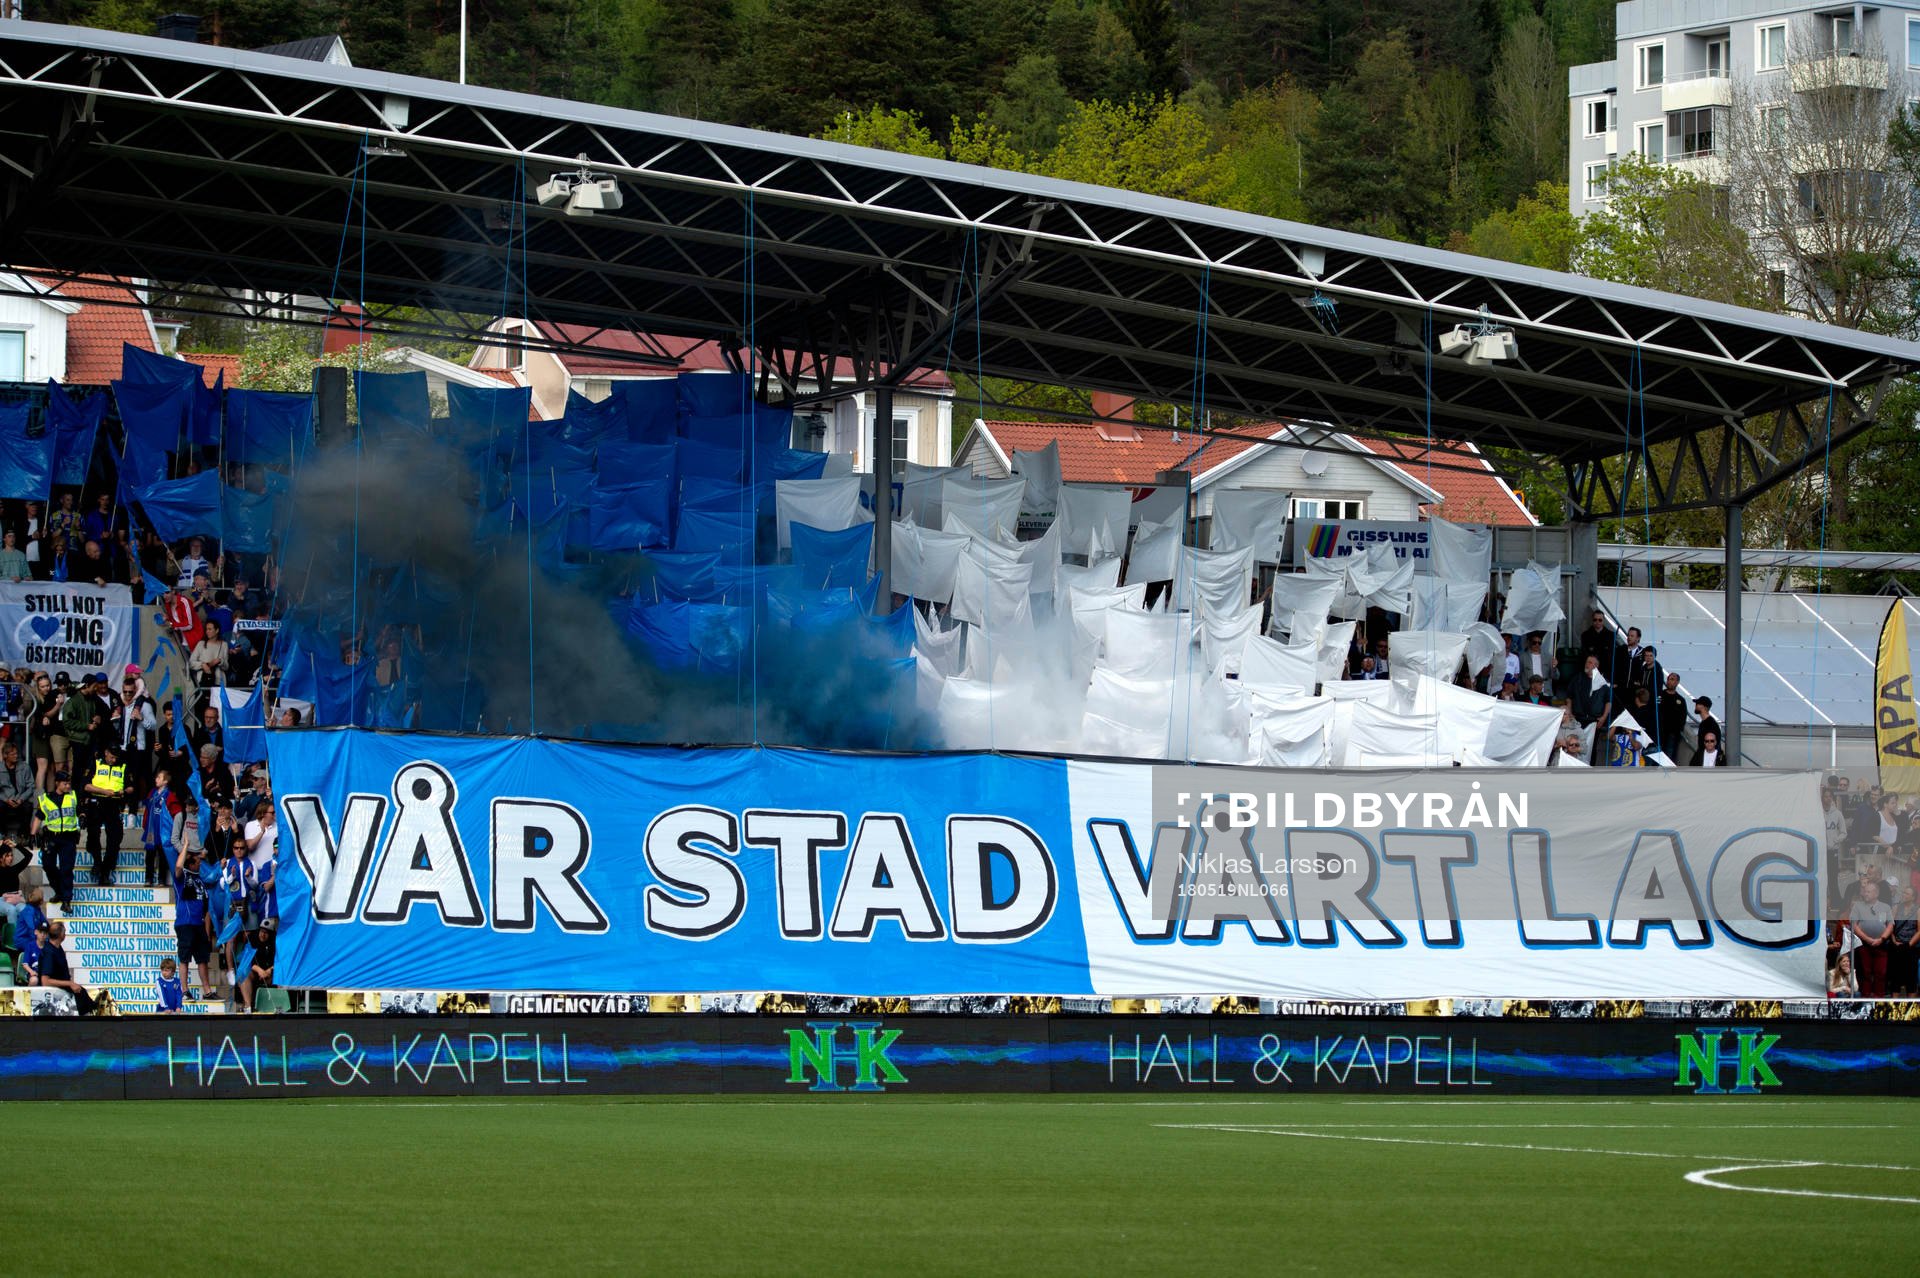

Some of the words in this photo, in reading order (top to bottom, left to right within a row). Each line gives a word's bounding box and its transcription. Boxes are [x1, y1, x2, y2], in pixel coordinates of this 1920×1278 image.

[1347, 530, 1428, 543] GISSLINS
[25, 594, 68, 612] STILL
[73, 596, 105, 615] NOT
[25, 643, 104, 666] ÖSTERSUND
[48, 807, 75, 820] POLIS
[281, 760, 610, 935] VÅR
[642, 803, 1059, 944] STAD
[1086, 794, 1478, 949] VÅRT
[1507, 827, 1820, 951] LAG
[115, 889, 154, 902] TIDNING
[123, 906, 162, 919] TIDNING
[69, 921, 128, 935] SUNDSVALLS
[131, 922, 170, 935] TIDNING
[75, 937, 134, 951] SUNDSVALLS
[136, 938, 177, 952] TIDNING
[82, 953, 142, 968] SUNDSVALLS
[89, 970, 149, 984] SUNDSVALLS
[167, 1034, 308, 1087] HALL
[327, 1032, 371, 1085] &
[392, 1032, 588, 1085] KAPELL
[1108, 1034, 1235, 1083] HALL
[1253, 1033, 1293, 1085] &
[1314, 1034, 1493, 1085] KAPELL
